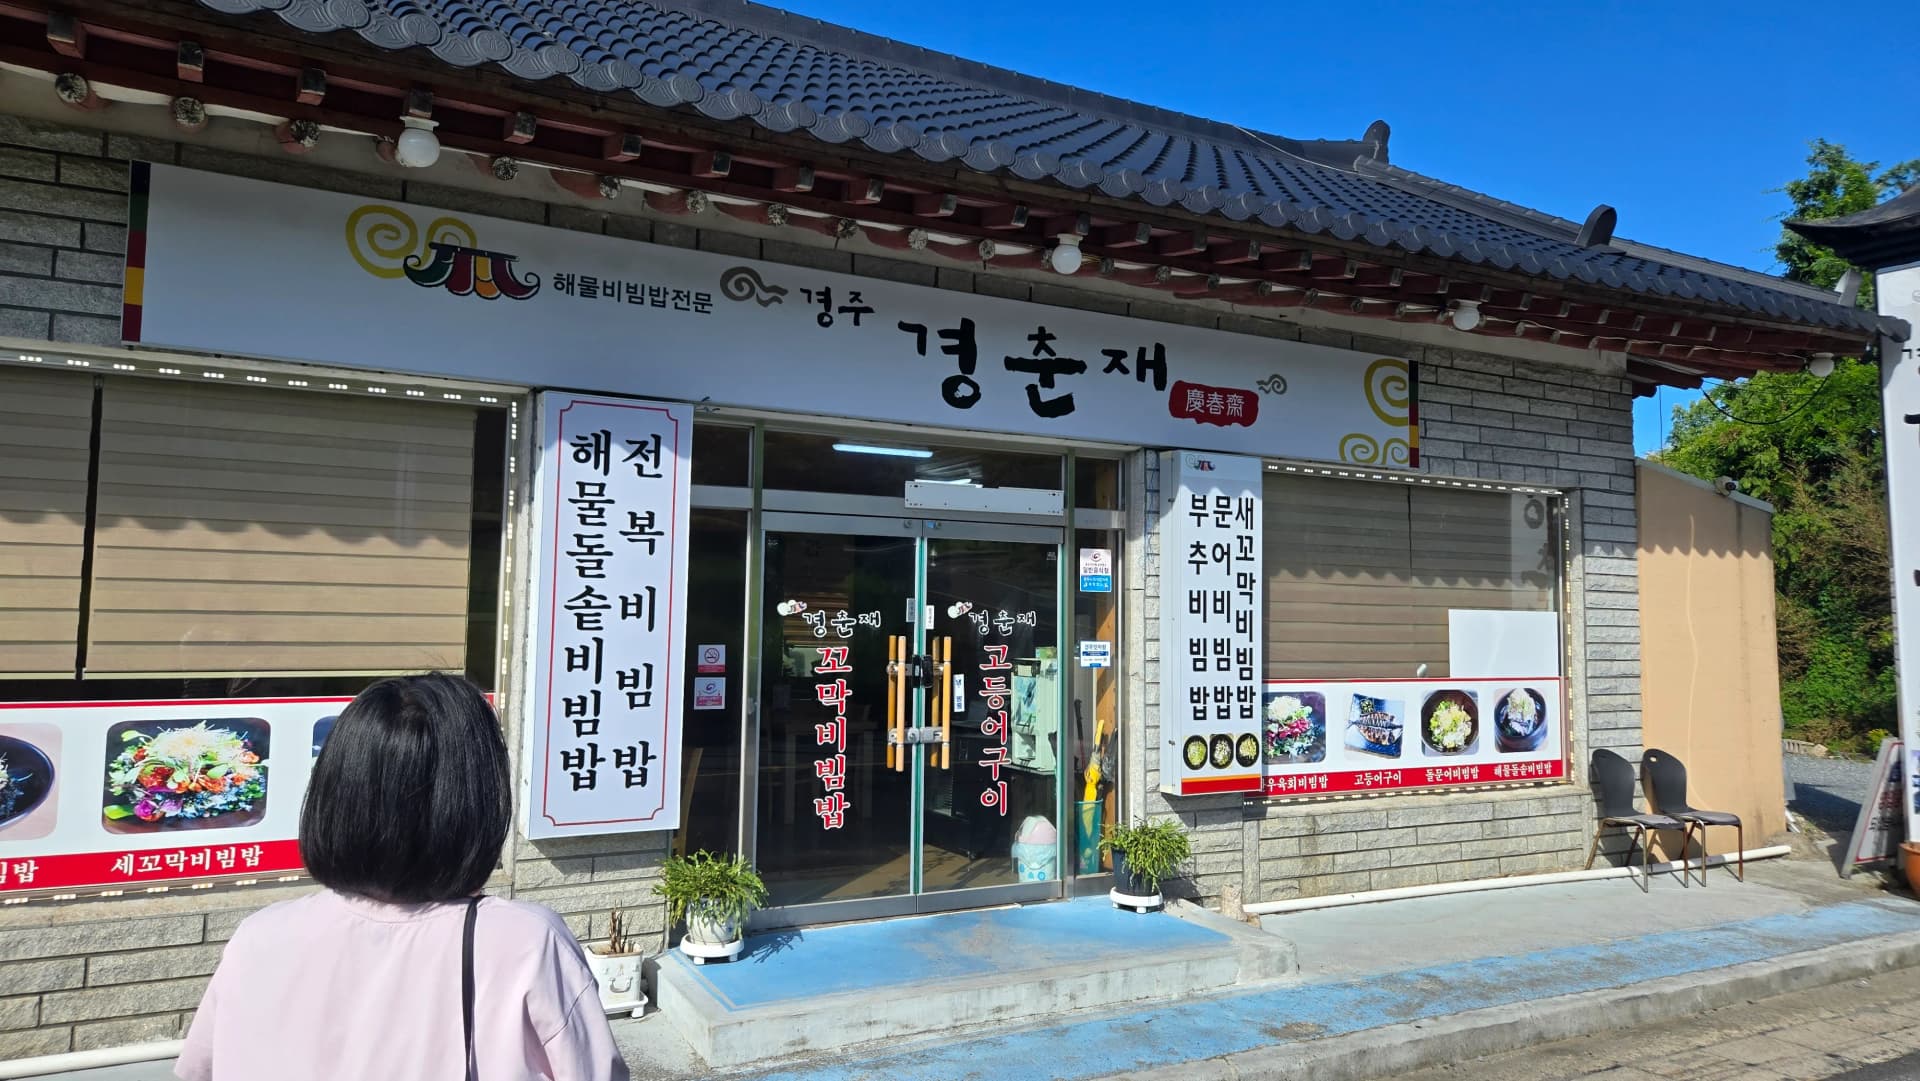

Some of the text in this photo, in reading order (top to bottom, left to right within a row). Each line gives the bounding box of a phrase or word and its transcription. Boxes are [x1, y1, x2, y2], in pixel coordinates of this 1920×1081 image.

[552, 272, 713, 315] 해물비빔밥전문
[799, 286, 1168, 419] 경주 경춘재
[1186, 388, 1245, 417] 慶春齋
[560, 428, 616, 792] 해물돌솥비빔밥
[612, 433, 665, 789] 전복비빔밥
[801, 610, 882, 638] 경춘재
[968, 610, 1037, 636] 경춘재
[1187, 493, 1210, 721] 부추비빔밥
[1212, 495, 1233, 721] 문어비빔밥
[1234, 496, 1256, 720] 새꼬막비빔밥
[814, 645, 853, 830] 꼬막비빔밥
[978, 645, 1012, 816] 고등어구이
[1425, 765, 1480, 782] 돌문어비빔밥
[1262, 773, 1329, 793] 우육회비빔밥
[1353, 770, 1402, 787] 고등어구이
[110, 844, 264, 877] 세꼬막비빔밥
